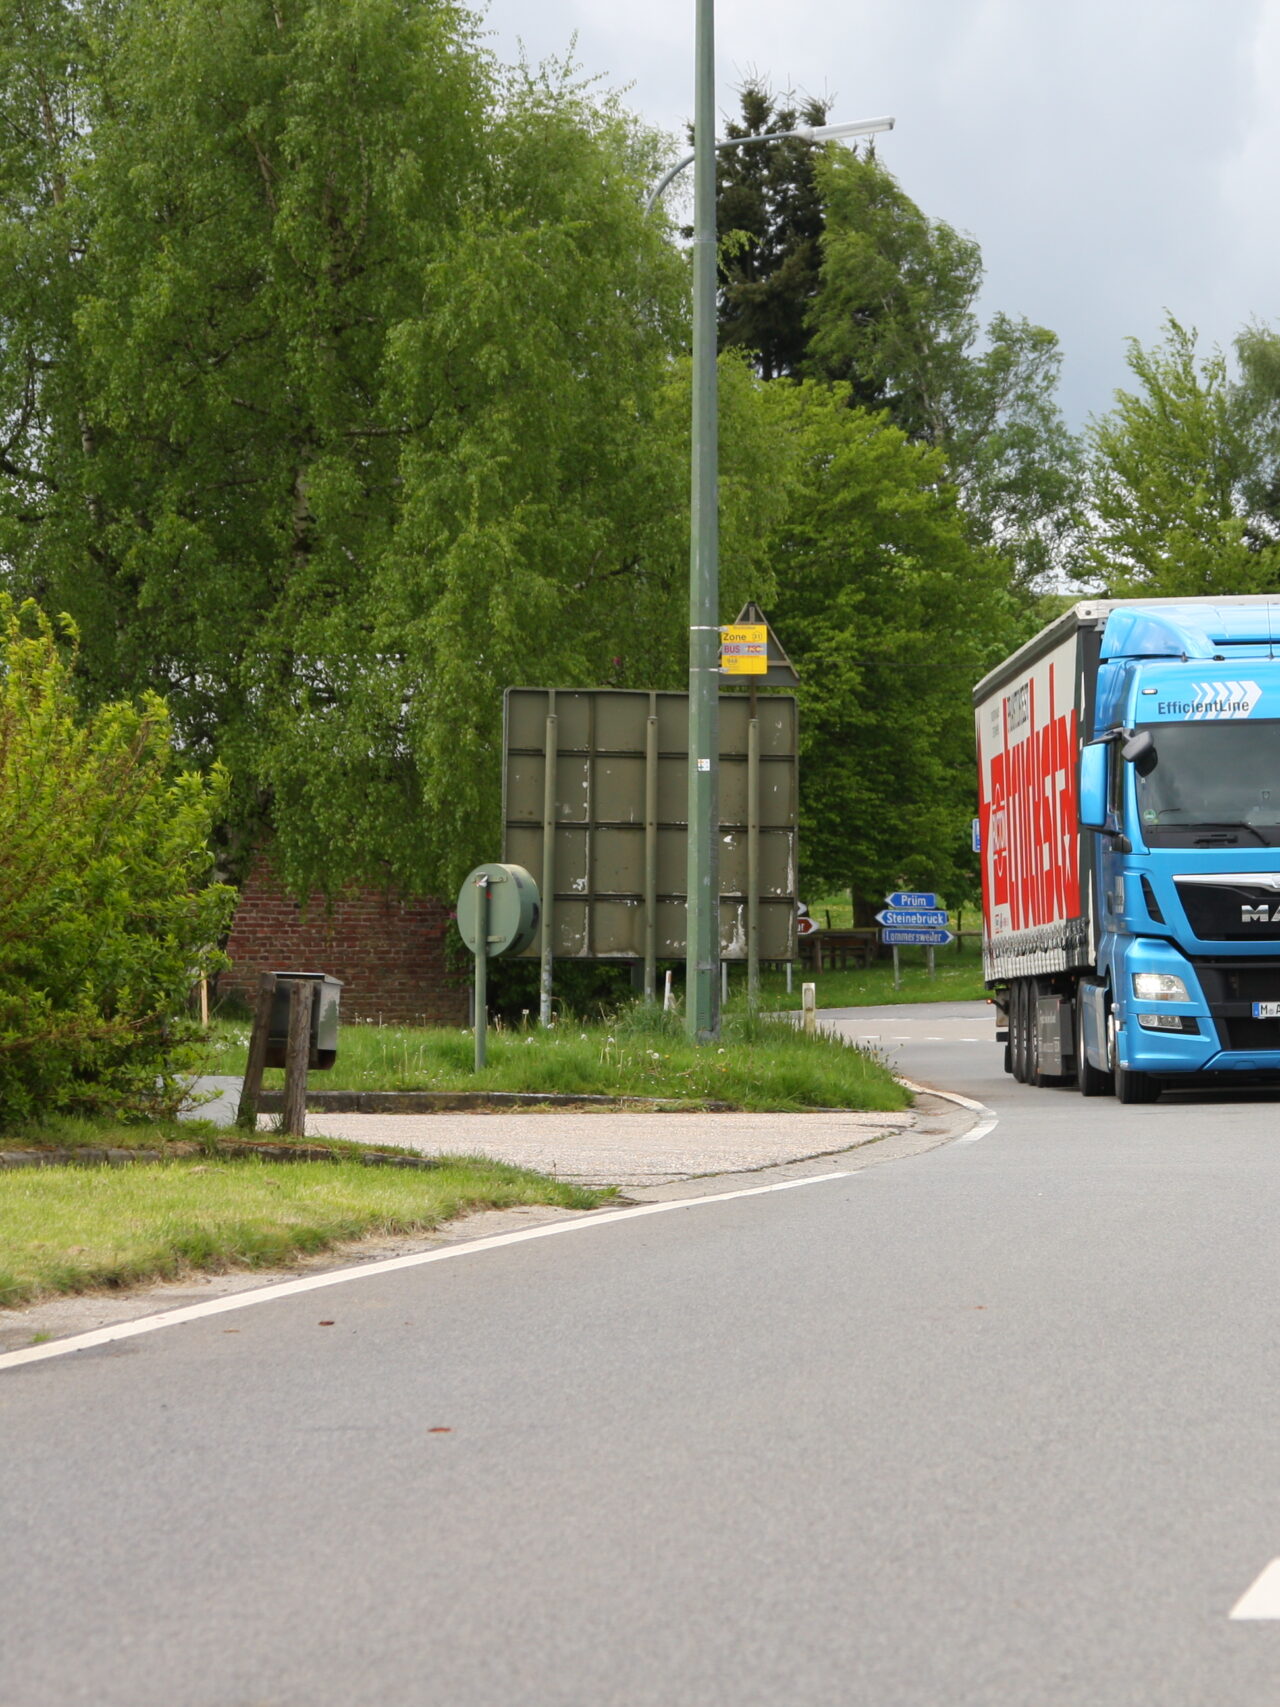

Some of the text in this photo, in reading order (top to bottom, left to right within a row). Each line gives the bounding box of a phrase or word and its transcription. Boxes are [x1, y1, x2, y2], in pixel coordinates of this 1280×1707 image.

[723, 632, 747, 641] Zone
[724, 645, 741, 653] BUS
[1158, 699, 1250, 715] EfficientLine
[901, 895, 927, 906] Prüm
[886, 912, 944, 924] Steinebrück
